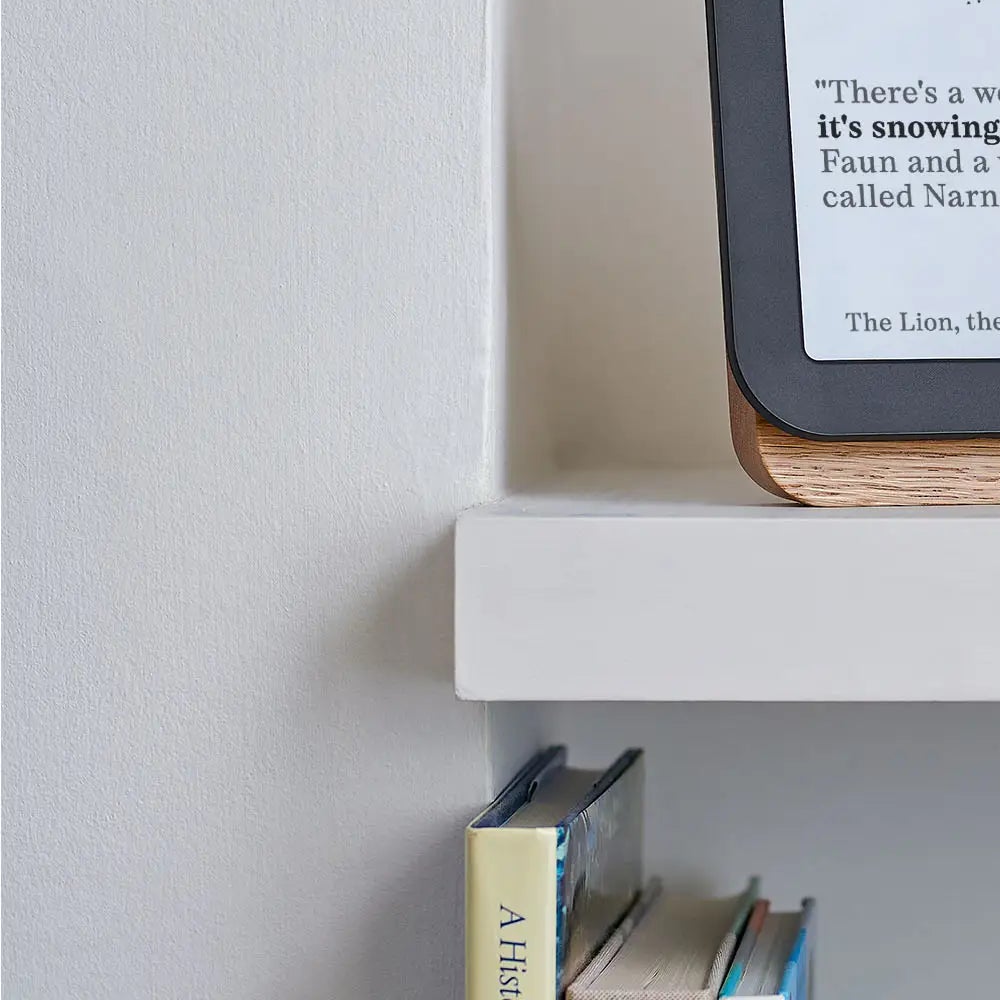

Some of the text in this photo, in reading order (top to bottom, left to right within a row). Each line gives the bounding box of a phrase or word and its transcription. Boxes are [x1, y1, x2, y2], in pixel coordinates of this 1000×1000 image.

[815, 80, 937, 104] "There's
[949, 87, 964, 103] a
[818, 114, 862, 138] it's
[820, 149, 898, 173] Faun
[909, 149, 964, 173] and
[974, 156, 989, 173] a
[823, 184, 914, 208] called
[845, 312, 892, 331] The
[900, 312, 959, 335] Lion,
[499, 905, 527, 1000] A Hist
